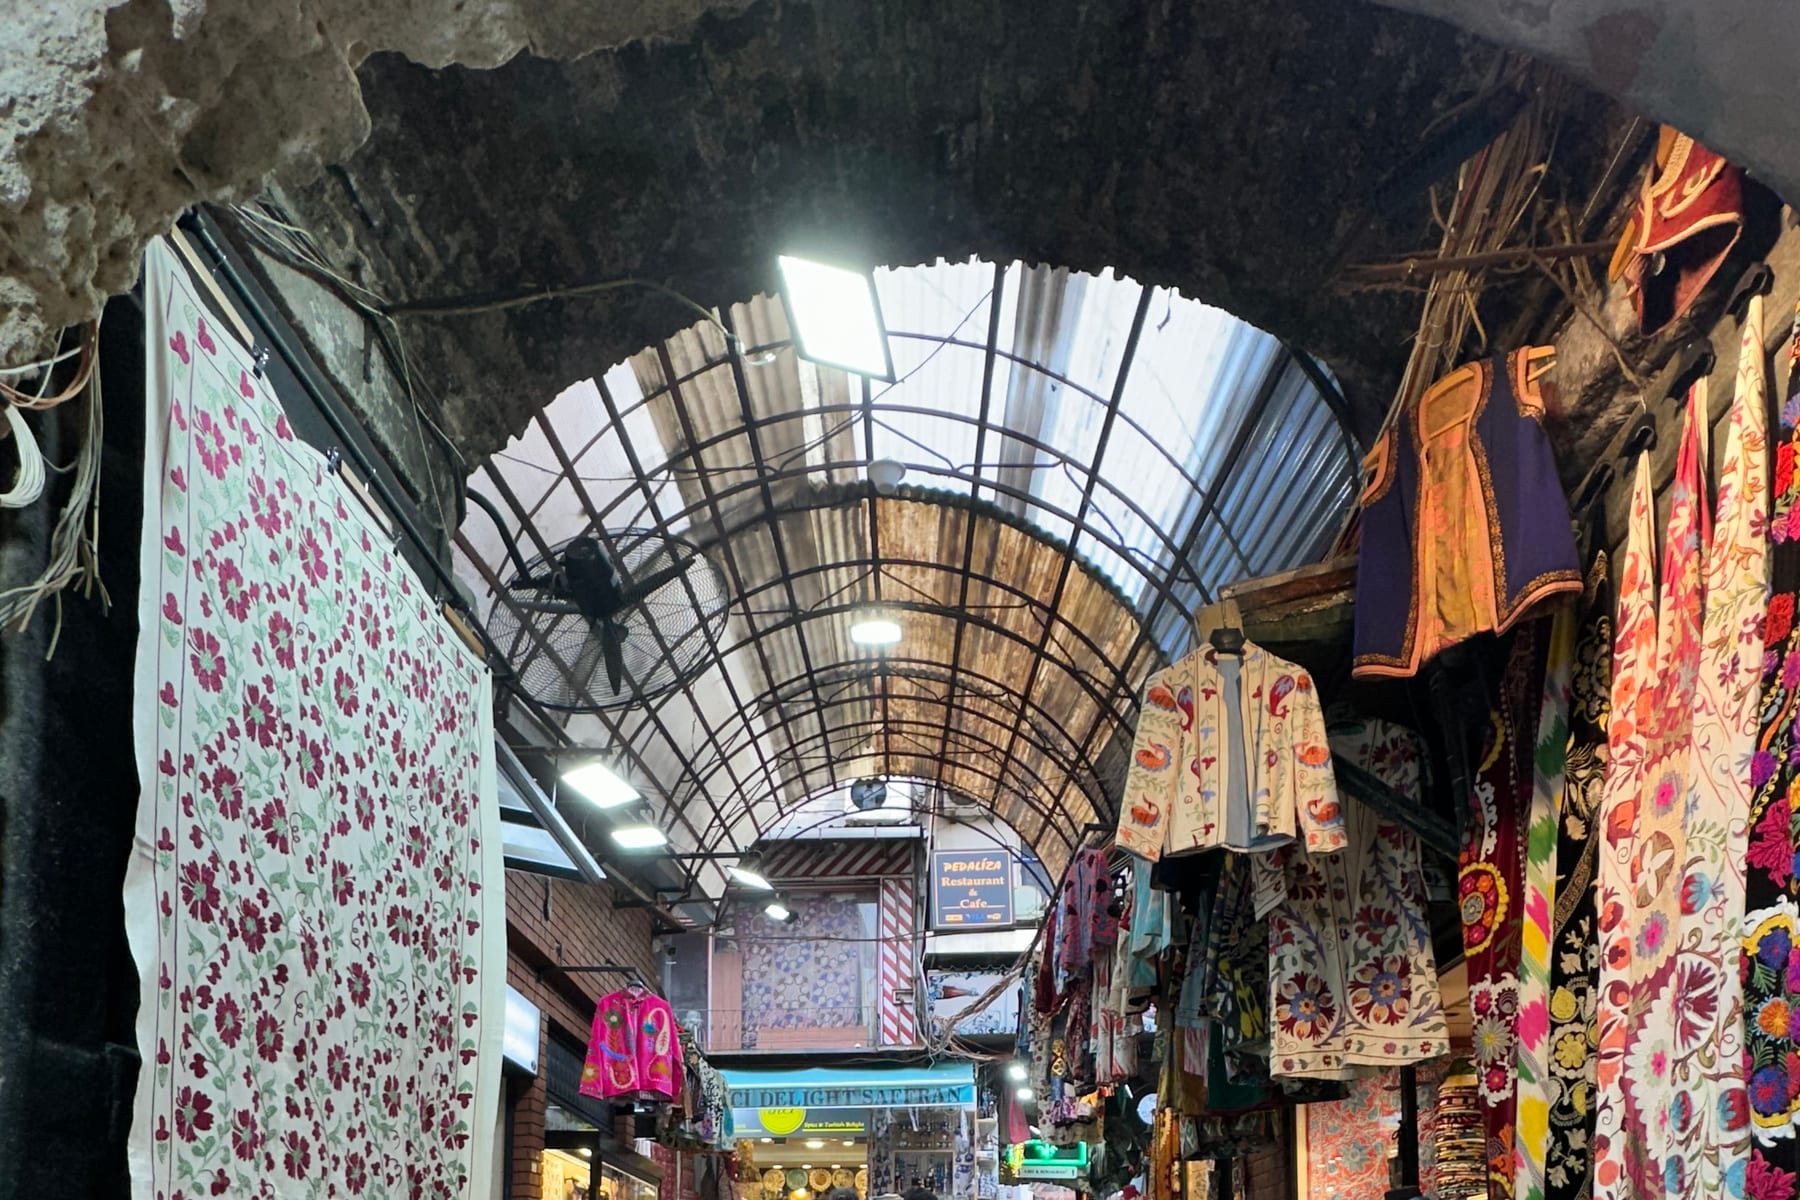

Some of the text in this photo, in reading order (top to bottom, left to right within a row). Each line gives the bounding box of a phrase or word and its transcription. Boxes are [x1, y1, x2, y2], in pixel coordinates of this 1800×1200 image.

[941, 876, 1004, 887] Restaurant
[968, 888, 978, 897] &
[960, 899, 988, 909] Cafe
[760, 1088, 856, 1106] DELIGHT
[862, 1087, 960, 1104] SAFFRAN
